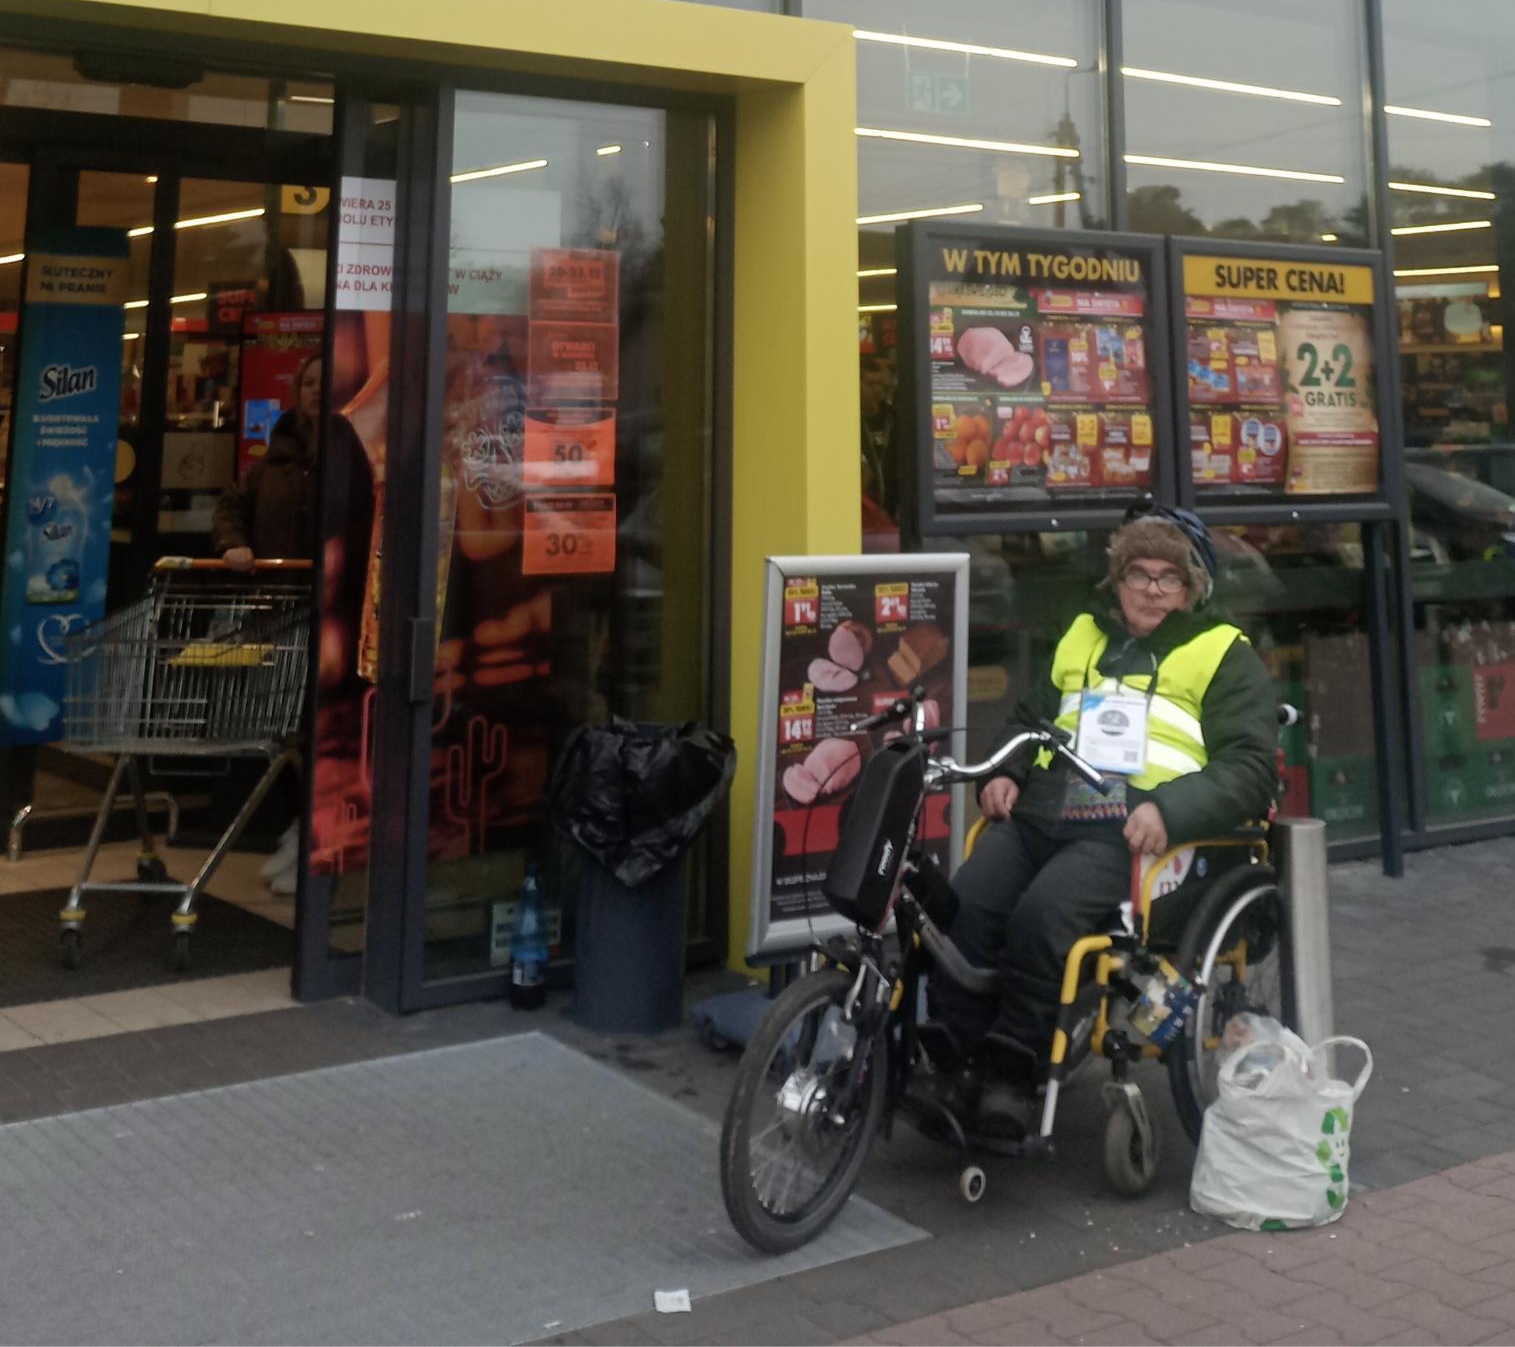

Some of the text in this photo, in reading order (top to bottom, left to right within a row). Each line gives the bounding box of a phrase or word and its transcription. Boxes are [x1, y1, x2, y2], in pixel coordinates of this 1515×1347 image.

[377, 199, 392, 211] 25
[346, 264, 393, 277] ZDROW
[943, 248, 1141, 283] W TYM TYGODNIU
[1214, 264, 1346, 295] SUPER CENA!
[1296, 342, 1357, 388] 2+2
[39, 363, 97, 401] Silan
[1304, 391, 1358, 408] GRATIS
